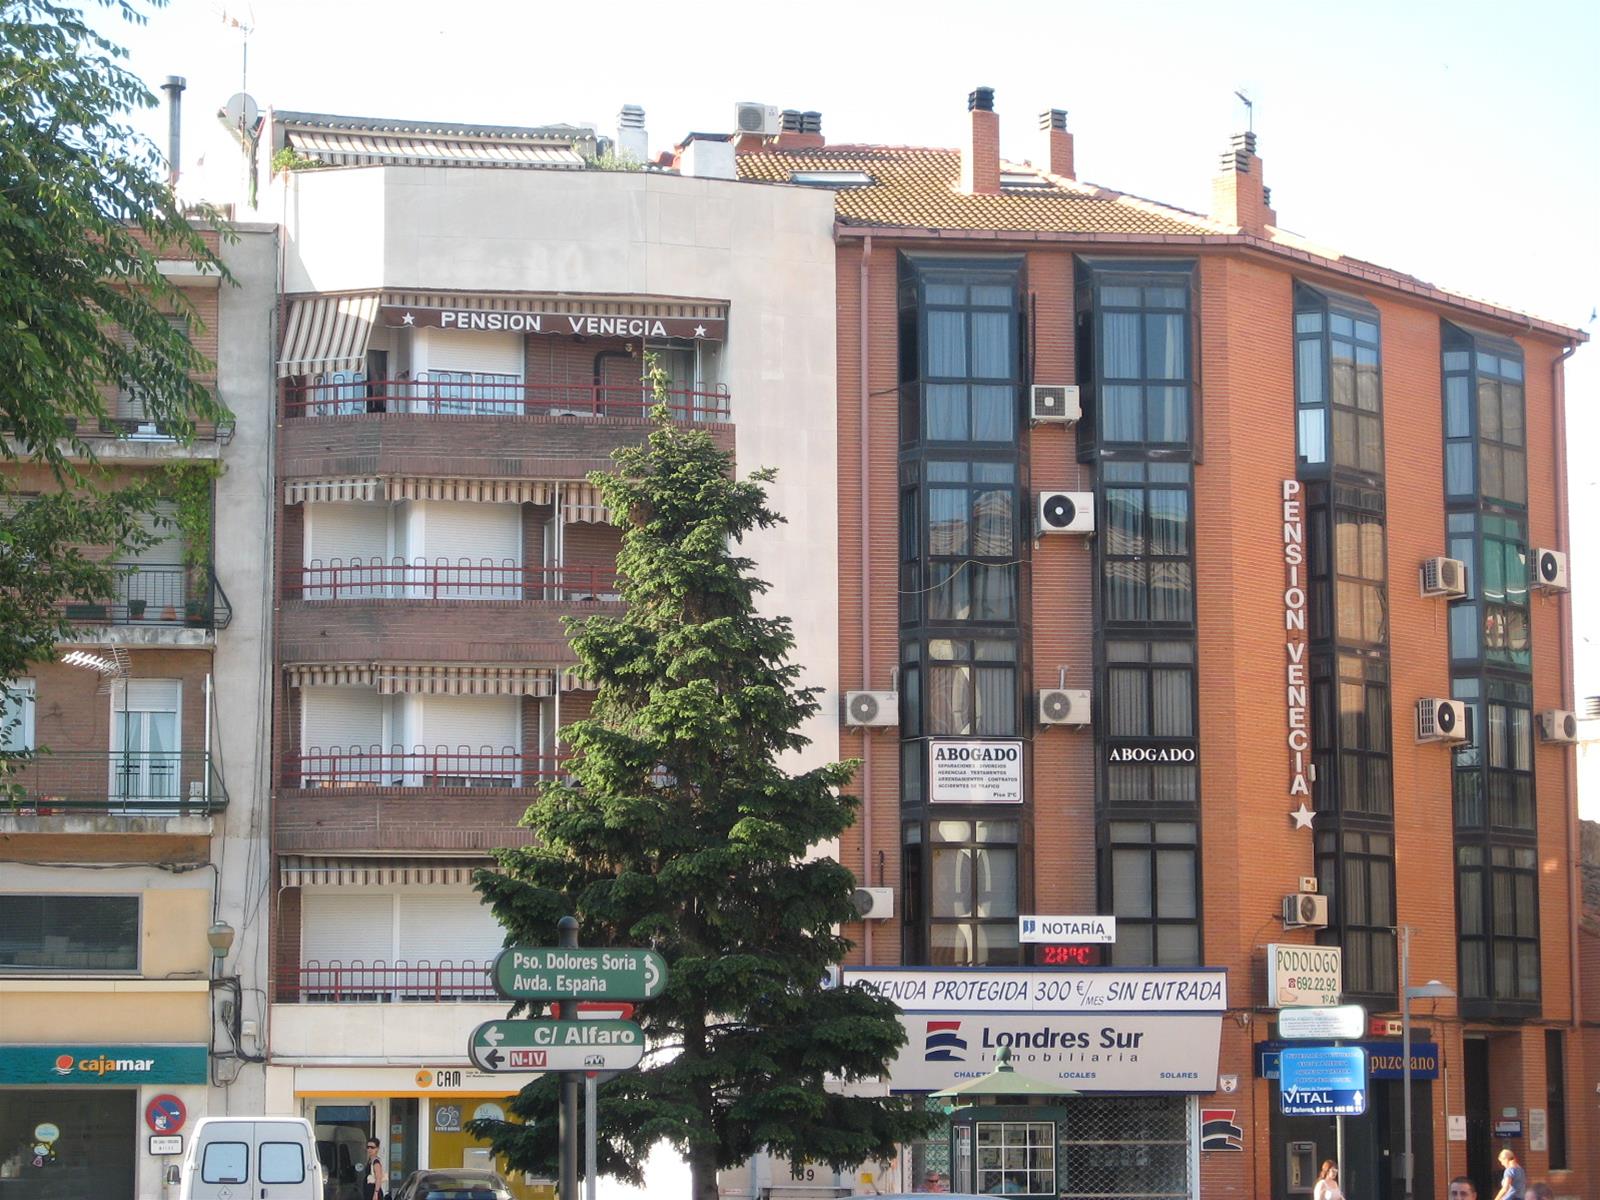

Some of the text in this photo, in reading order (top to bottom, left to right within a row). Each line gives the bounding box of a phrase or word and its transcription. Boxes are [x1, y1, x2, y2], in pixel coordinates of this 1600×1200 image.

[440, 311, 668, 337] PENSION VENECIA
[1282, 479, 1310, 796] PENSION VENECIA
[935, 748, 1017, 761] ABOGADO
[1110, 748, 1195, 761] ABOGADO
[1042, 920, 1105, 934] NOTARÍA
[514, 952, 637, 971] Pso. Dolores Soria
[1278, 951, 1338, 974] PODOLOGO
[513, 974, 607, 997] Avda. España
[931, 980, 1028, 1001] PROTEGIDA
[1034, 980, 1072, 1001] 300
[1107, 981, 1139, 1001] SIN
[1141, 981, 1221, 1001] ENTRADA
[534, 1026, 635, 1047] C/ Alfaro
[982, 1027, 1144, 1049] Londres Sur
[78, 1055, 154, 1076] cajamar
[511, 1052, 545, 1066] N-IV
[1370, 1055, 1435, 1073] puzcano
[436, 1071, 461, 1087] CAM
[953, 1071, 992, 1079] CHALET
[1283, 1092, 1334, 1104] VITAL
